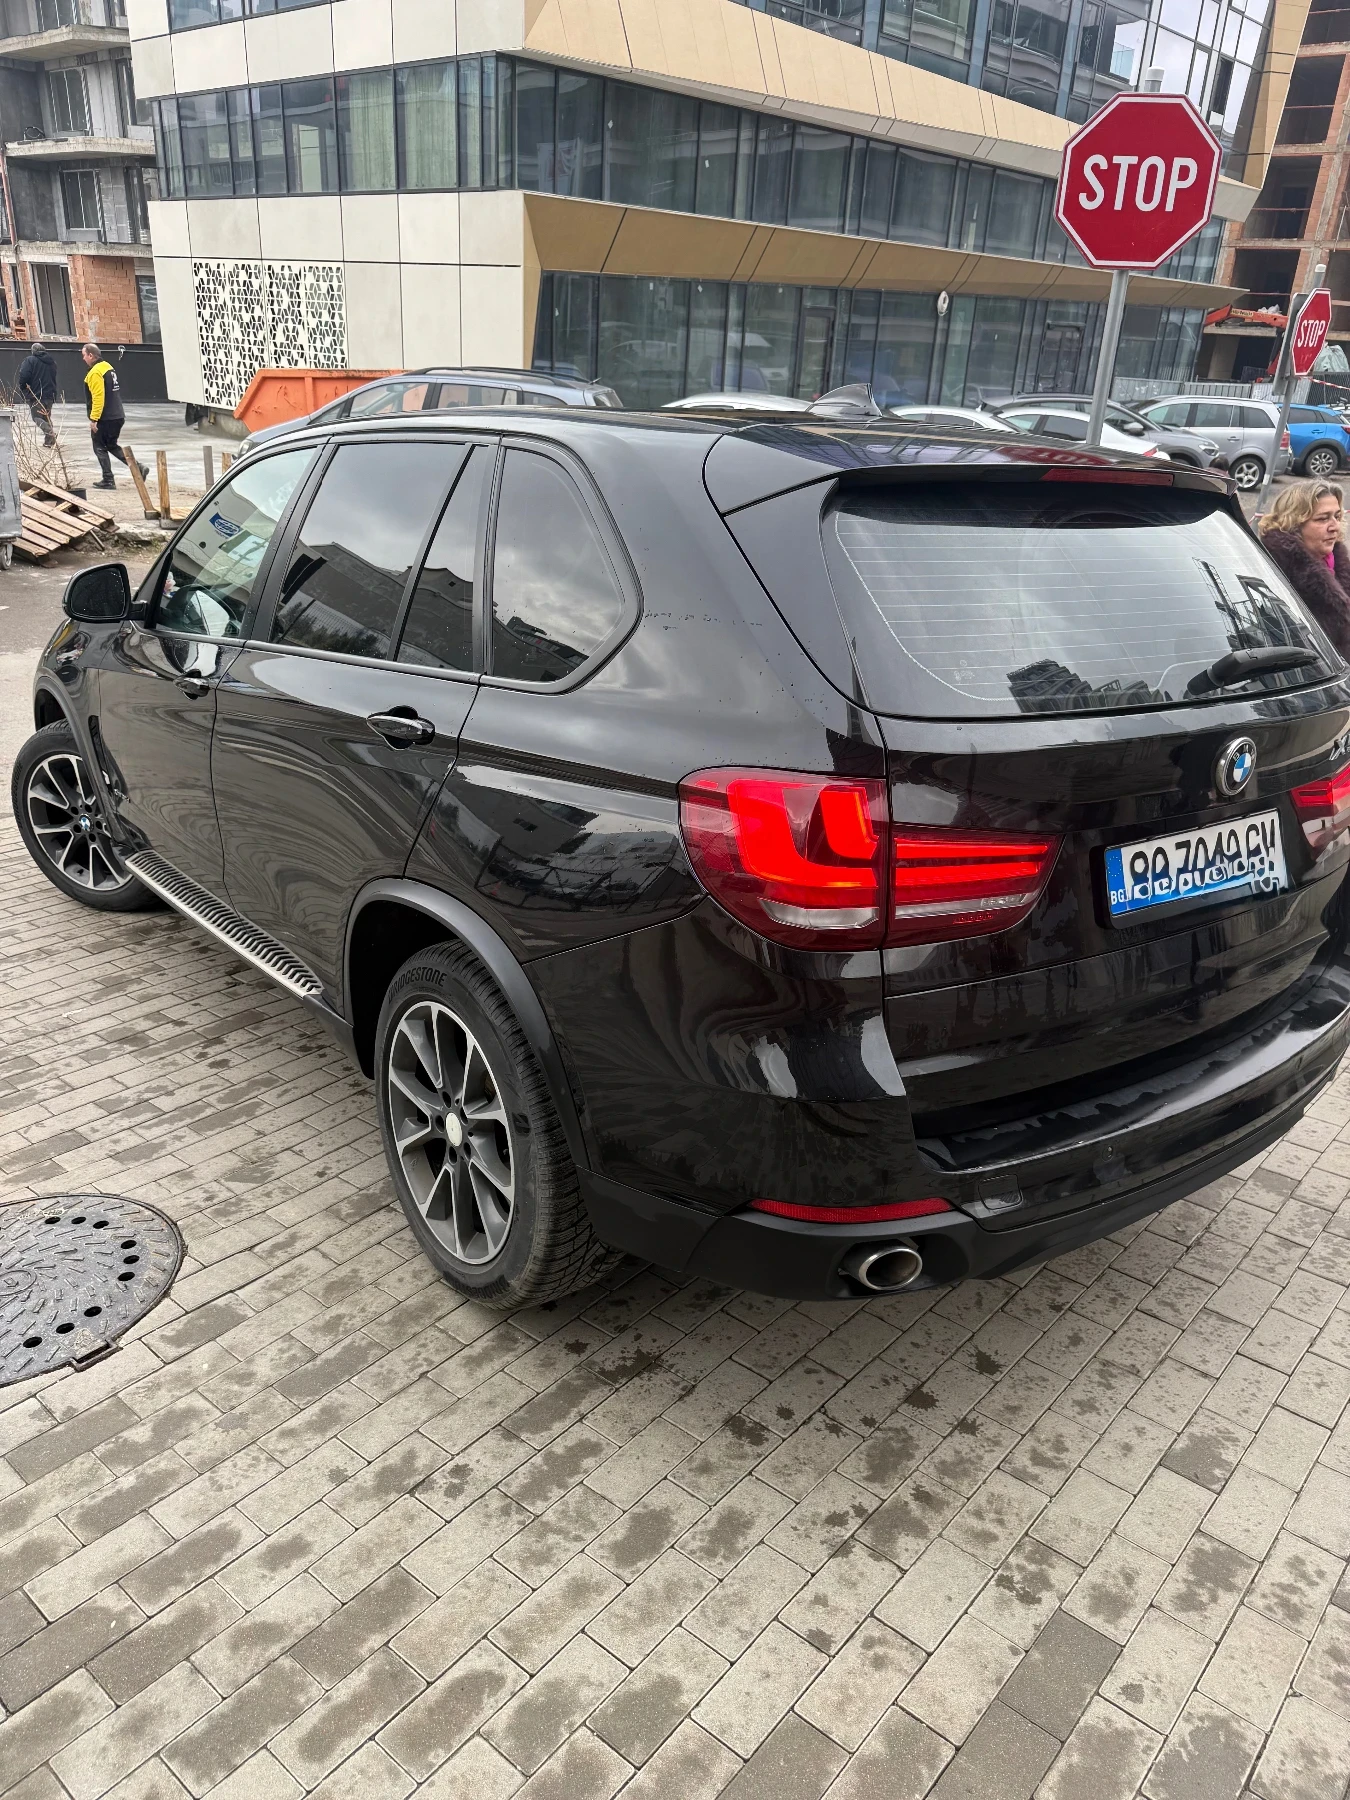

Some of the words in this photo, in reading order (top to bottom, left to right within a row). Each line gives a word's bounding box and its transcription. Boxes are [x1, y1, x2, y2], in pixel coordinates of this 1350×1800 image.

[1078, 153, 1198, 213] STOP
[1297, 319, 1326, 348] STOP
[1110, 889, 1125, 905] BG
[388, 966, 448, 1004] BRIDGESTONE
